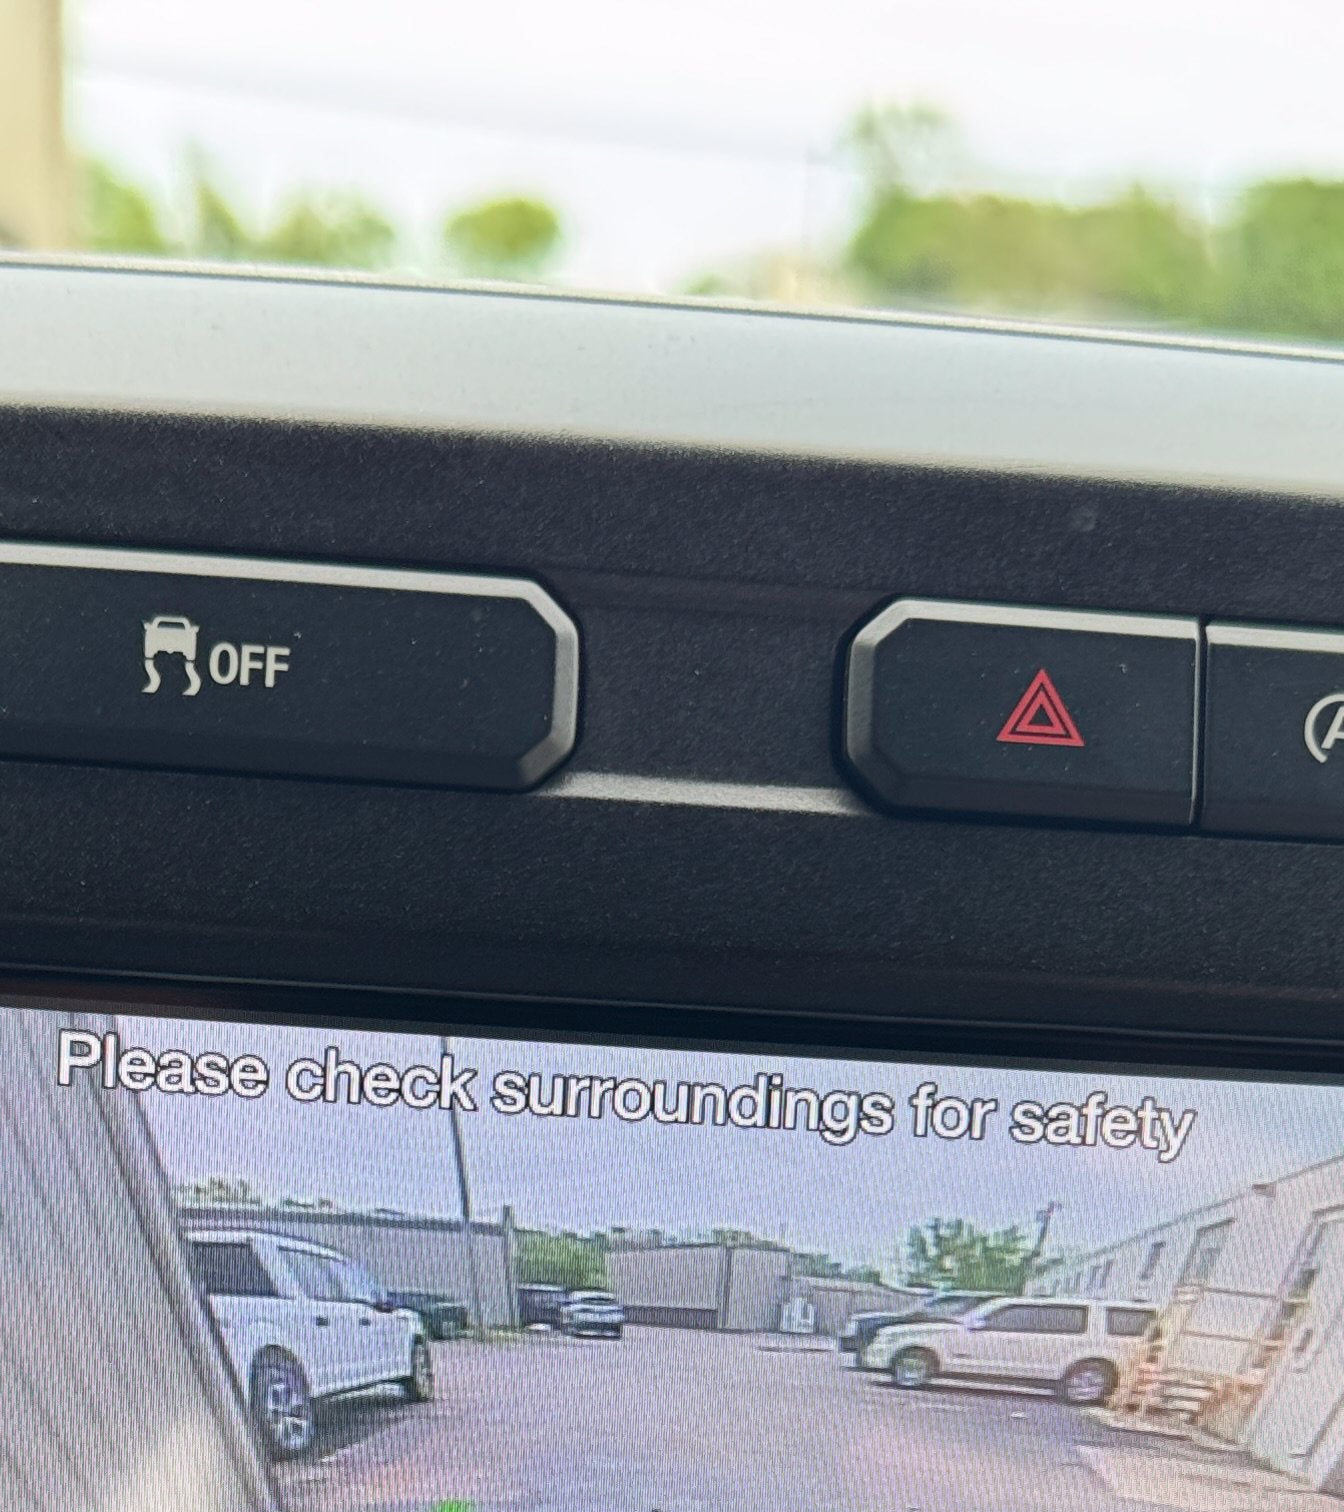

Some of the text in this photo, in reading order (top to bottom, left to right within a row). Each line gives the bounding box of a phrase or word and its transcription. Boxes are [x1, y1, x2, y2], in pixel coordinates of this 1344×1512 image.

[209, 642, 291, 689] OFF
[56, 1029, 1196, 1162] Please check surroundings for safety
